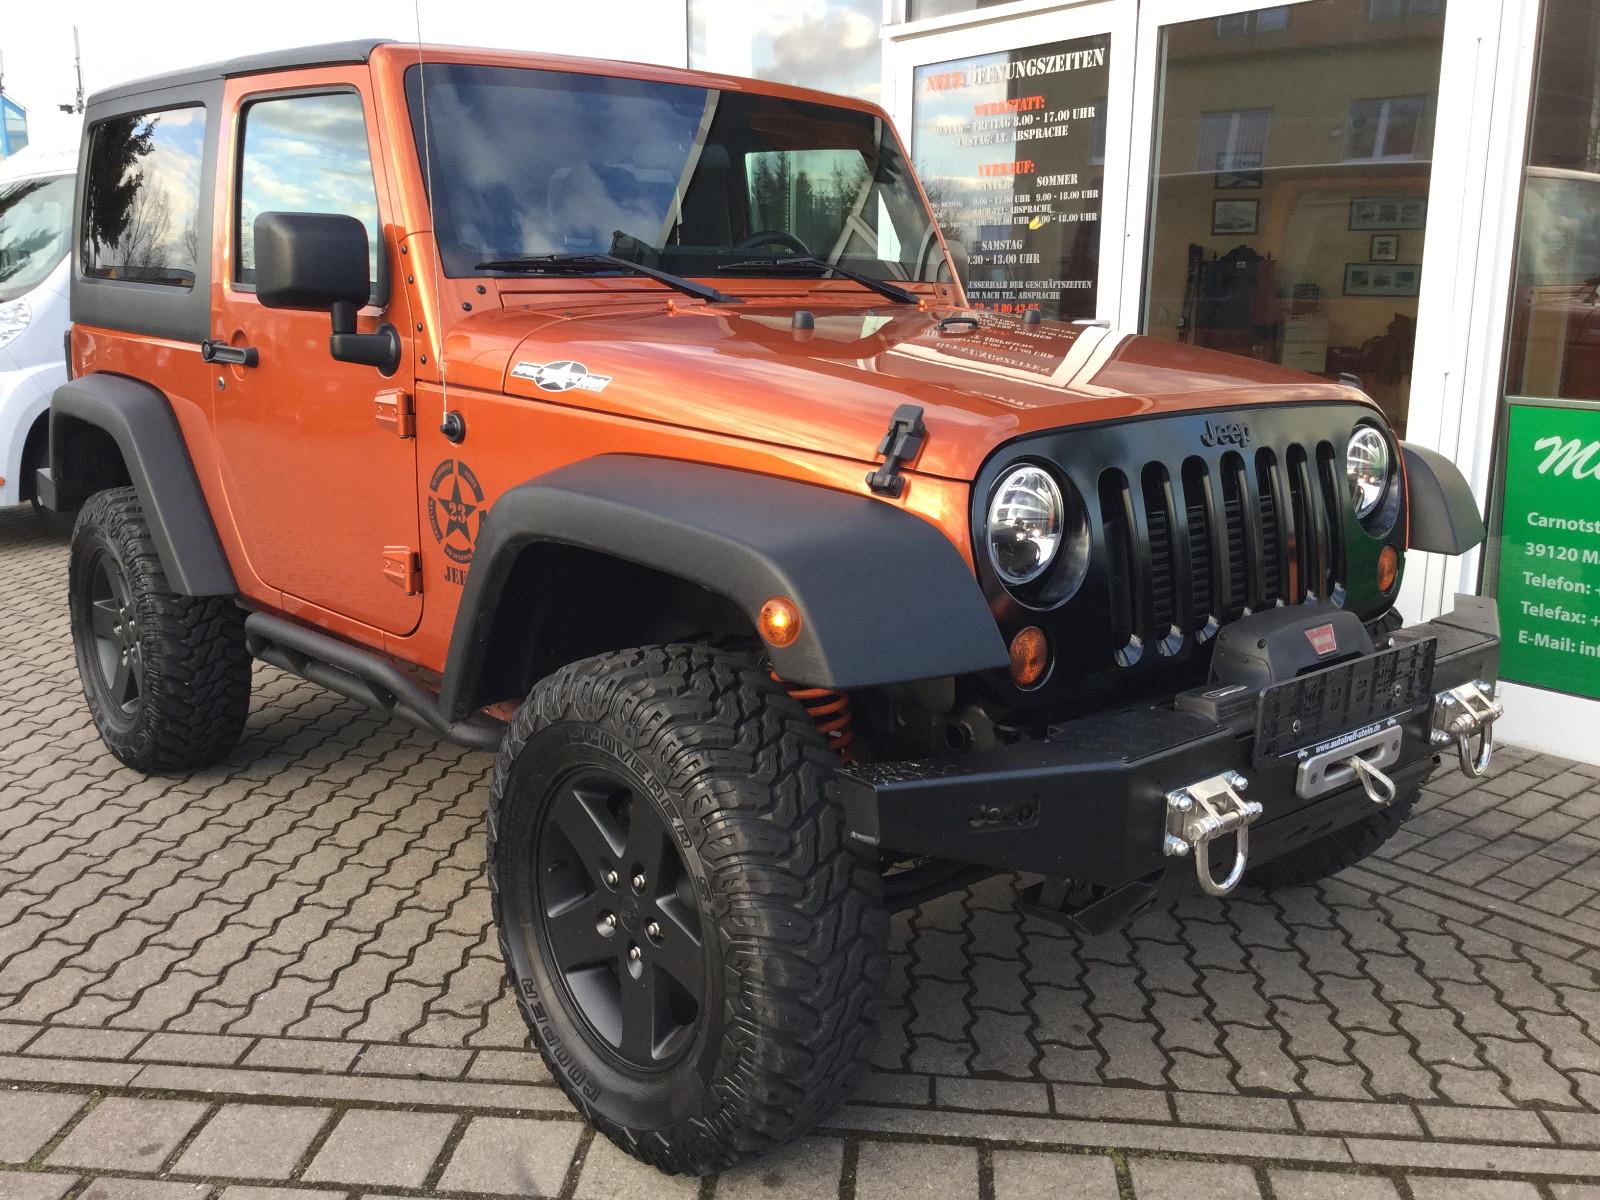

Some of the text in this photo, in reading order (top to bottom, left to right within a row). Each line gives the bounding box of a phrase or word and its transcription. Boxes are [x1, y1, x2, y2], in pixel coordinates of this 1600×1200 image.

[1043, 110, 1070, 123] 17.00
[1072, 106, 1096, 120] UHR
[1011, 125, 1069, 141] ABSPRACHE
[1036, 173, 1078, 187] SOMMER
[1014, 194, 1031, 203] UHR
[1035, 192, 1052, 202] 9.00
[1059, 191, 1080, 201] 18.00
[1081, 189, 1099, 199] UHR
[1011, 203, 1053, 214] ABSPRACHE
[1058, 213, 1079, 223] 18.00
[1080, 212, 1098, 222] UHR
[981, 239, 1023, 251] SAMSTAG
[992, 253, 1017, 265] 13.00
[1019, 253, 1041, 264] UHR
[968, 277, 1093, 289] USSERHALB DER GESCHÄFTSZEITEN
[967, 291, 981, 300] ERN
[981, 291, 1000, 300] NACH
[1017, 291, 1061, 300] ABSPRACHE
[1199, 419, 1251, 449] Jeep
[1534, 436, 1600, 480] M
[448, 501, 466, 523] 23
[1525, 542, 1600, 565] 39120 M
[444, 566, 467, 586] JEE
[1523, 571, 1591, 595] Telefon:
[1521, 600, 1587, 625] Telefax:
[1518, 629, 1576, 653] E-Mail:
[521, 978, 601, 1103] COOPER
